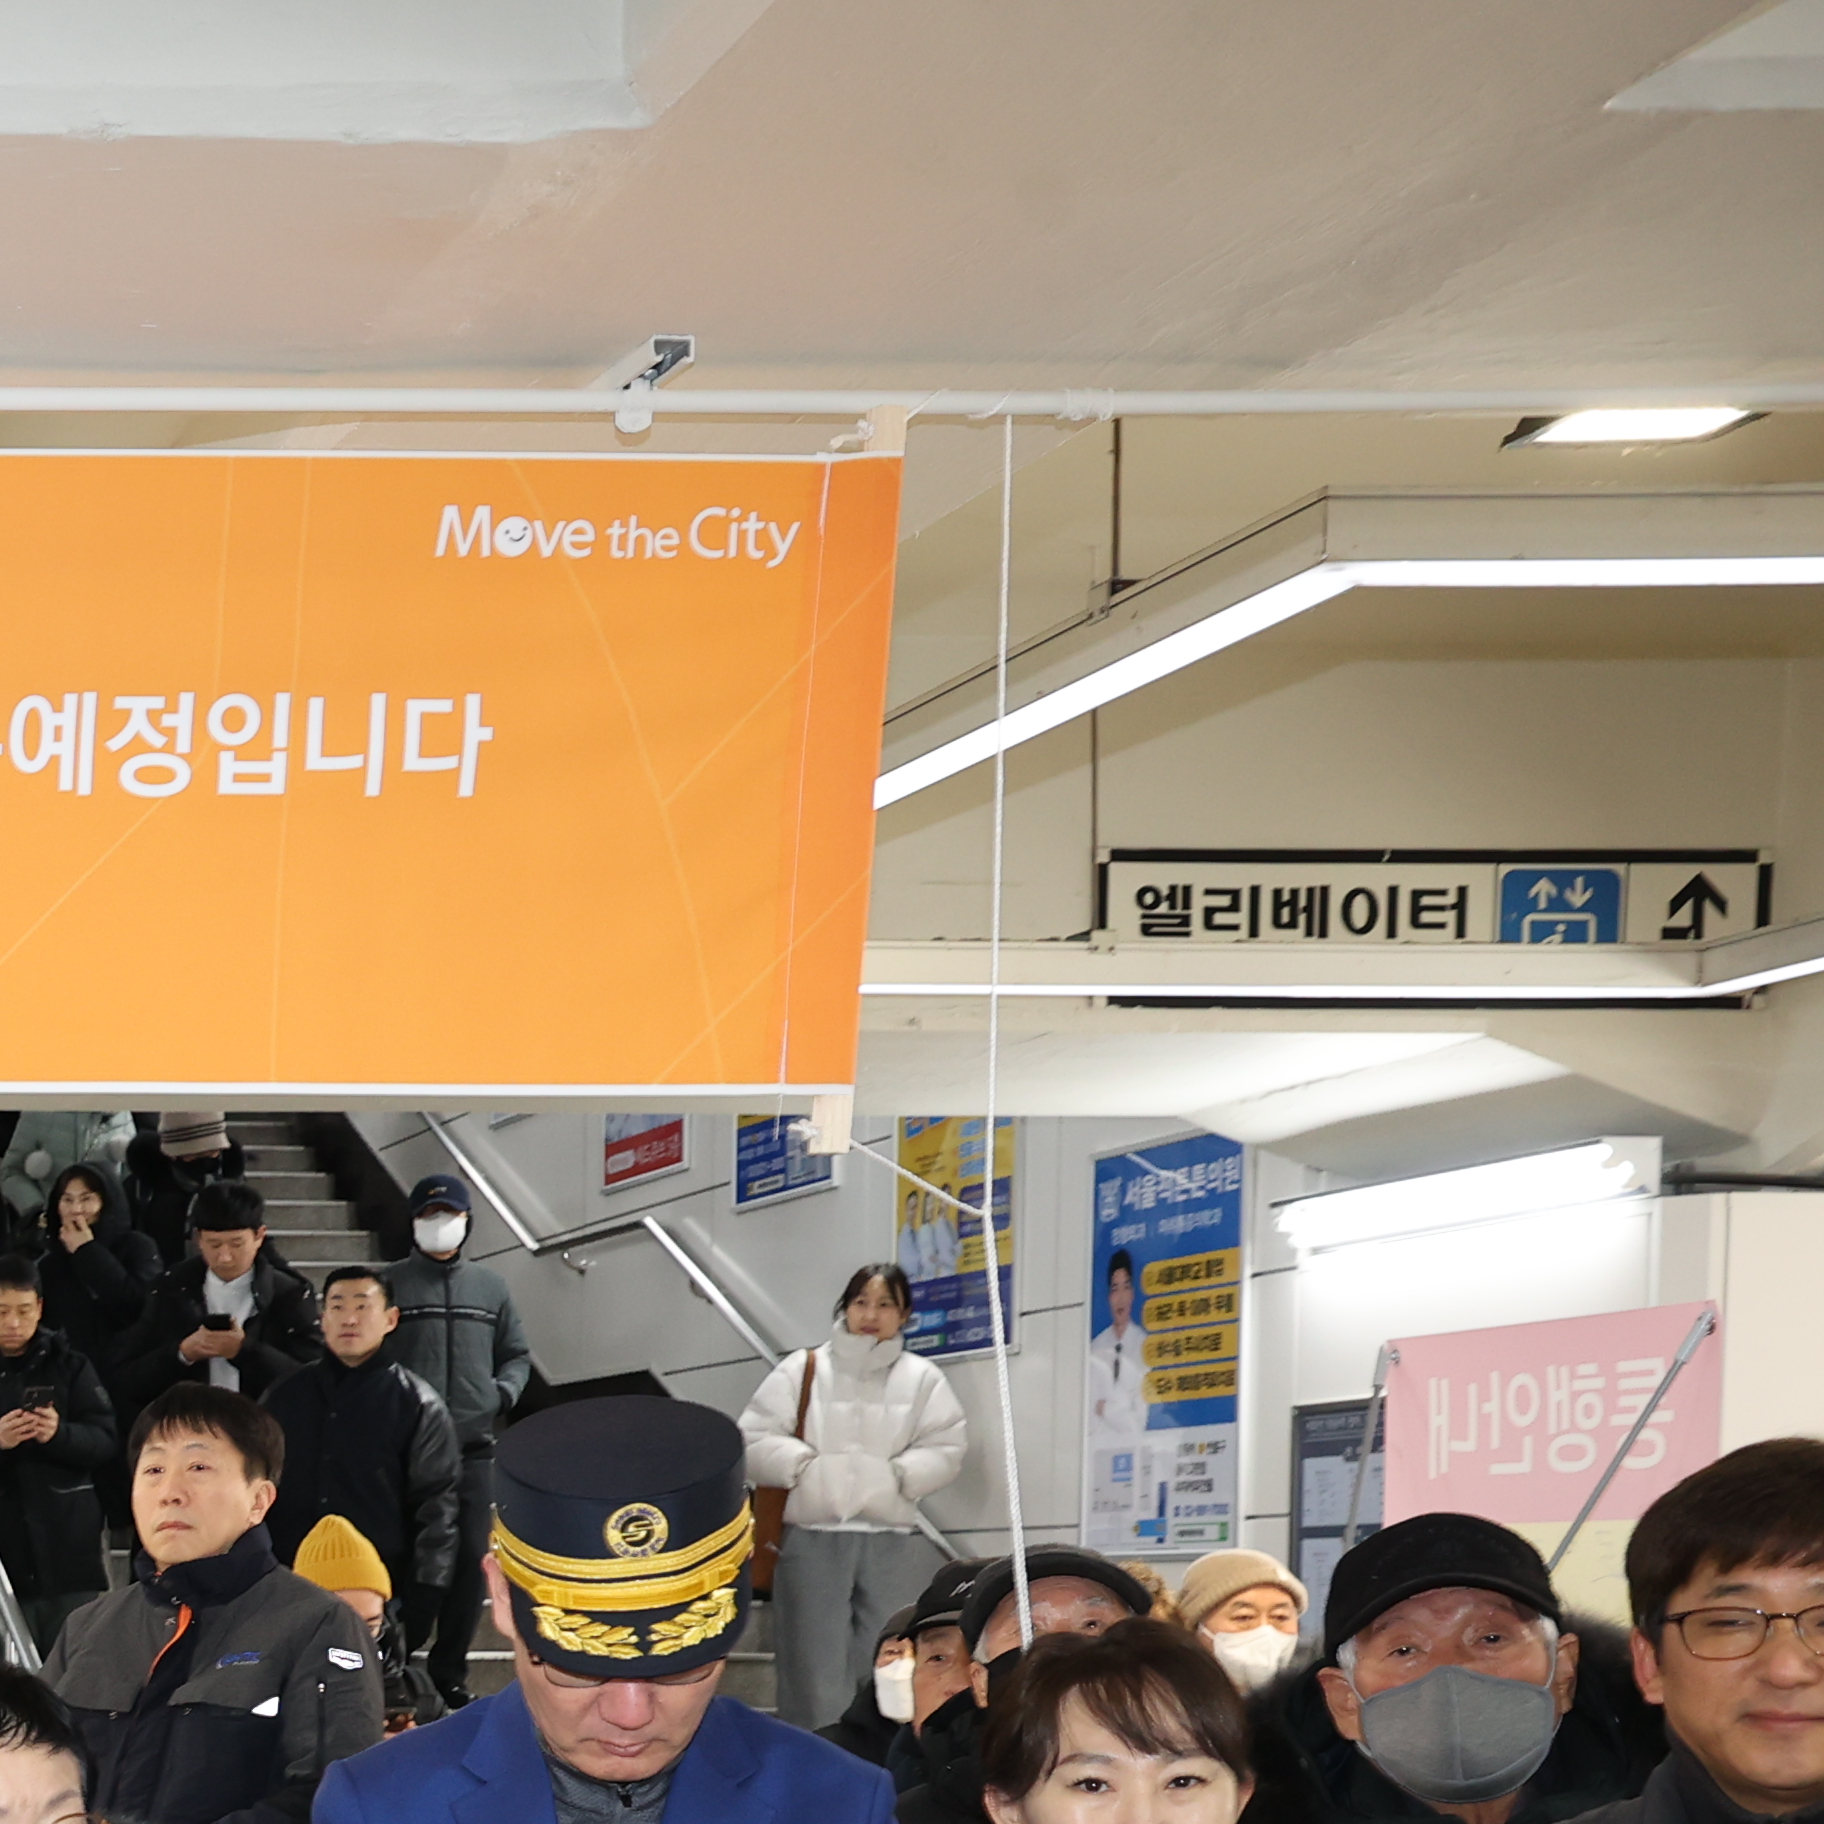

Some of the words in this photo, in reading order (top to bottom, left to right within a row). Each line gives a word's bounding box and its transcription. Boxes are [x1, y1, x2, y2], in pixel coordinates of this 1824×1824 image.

[434, 503, 597, 559] Move
[605, 513, 681, 560] the
[689, 506, 801, 569] City
[1134, 882, 1470, 941] 엘리베이터
